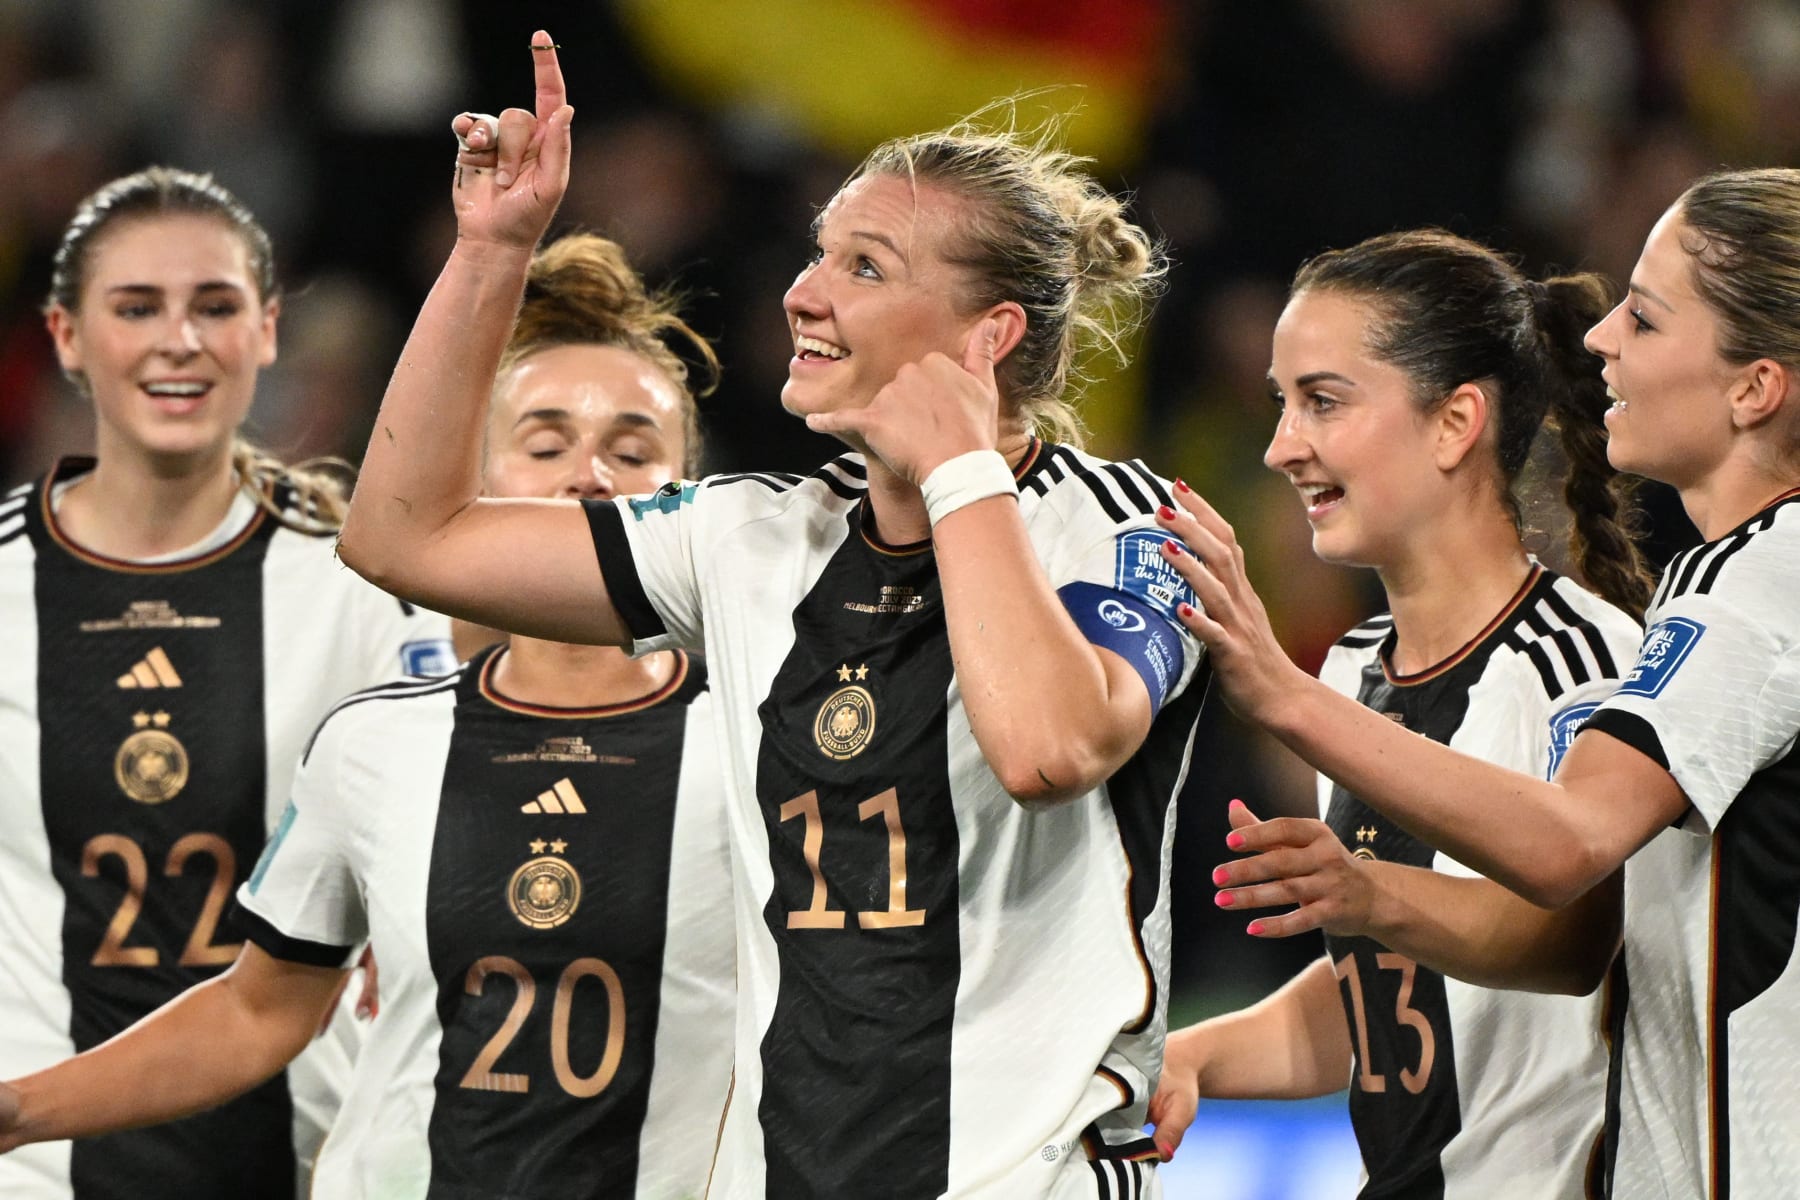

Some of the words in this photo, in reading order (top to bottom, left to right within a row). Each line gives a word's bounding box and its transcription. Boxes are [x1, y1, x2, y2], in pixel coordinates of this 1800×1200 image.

[1133, 565, 1155, 579] the
[1156, 570, 1187, 599] World
[81, 832, 245, 967] 22
[779, 786, 927, 930] 11
[459, 955, 626, 1098] 20
[1335, 952, 1435, 1095] 13
